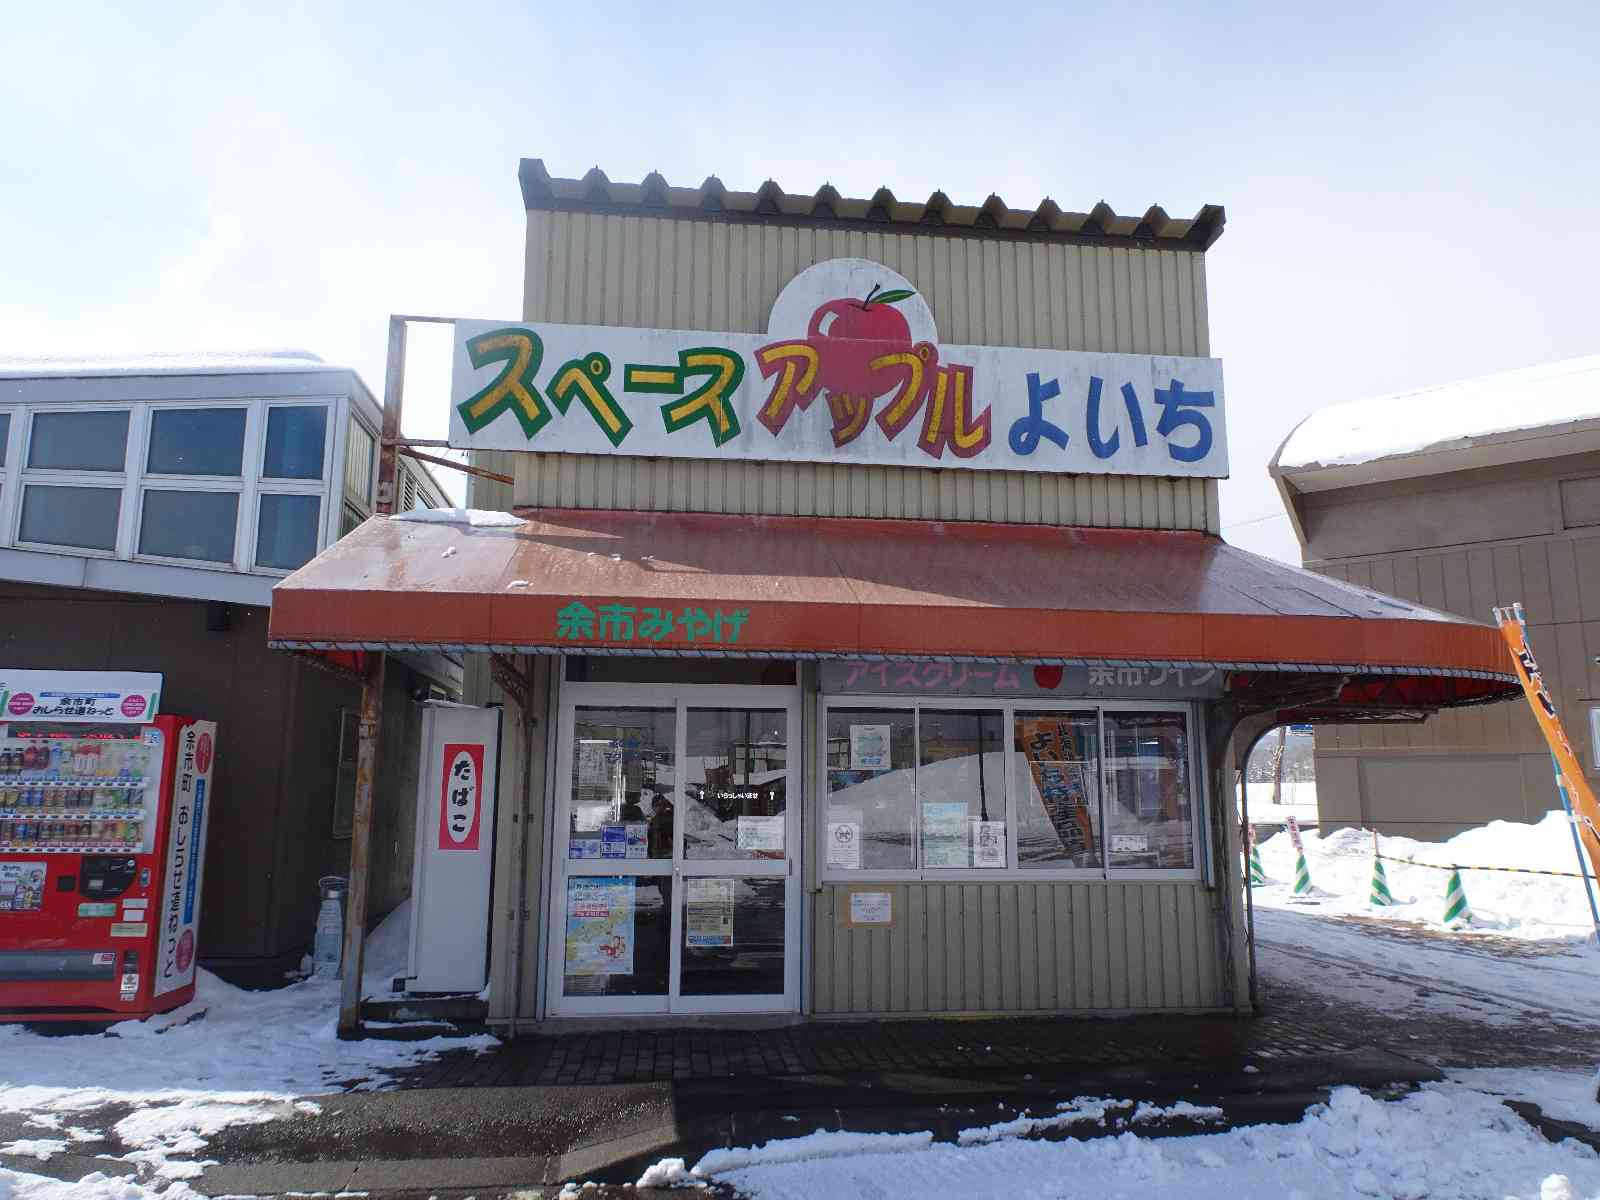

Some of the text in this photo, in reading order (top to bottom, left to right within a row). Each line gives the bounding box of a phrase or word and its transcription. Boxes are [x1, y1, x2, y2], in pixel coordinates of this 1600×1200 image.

[457, 328, 1216, 462] スペース アップル よいち
[556, 601, 750, 643] 余市みやげ
[846, 661, 1021, 688] アイスクリーム
[452, 760, 474, 833] たばこ
[717, 791, 759, 800] いらっしゃいませ
